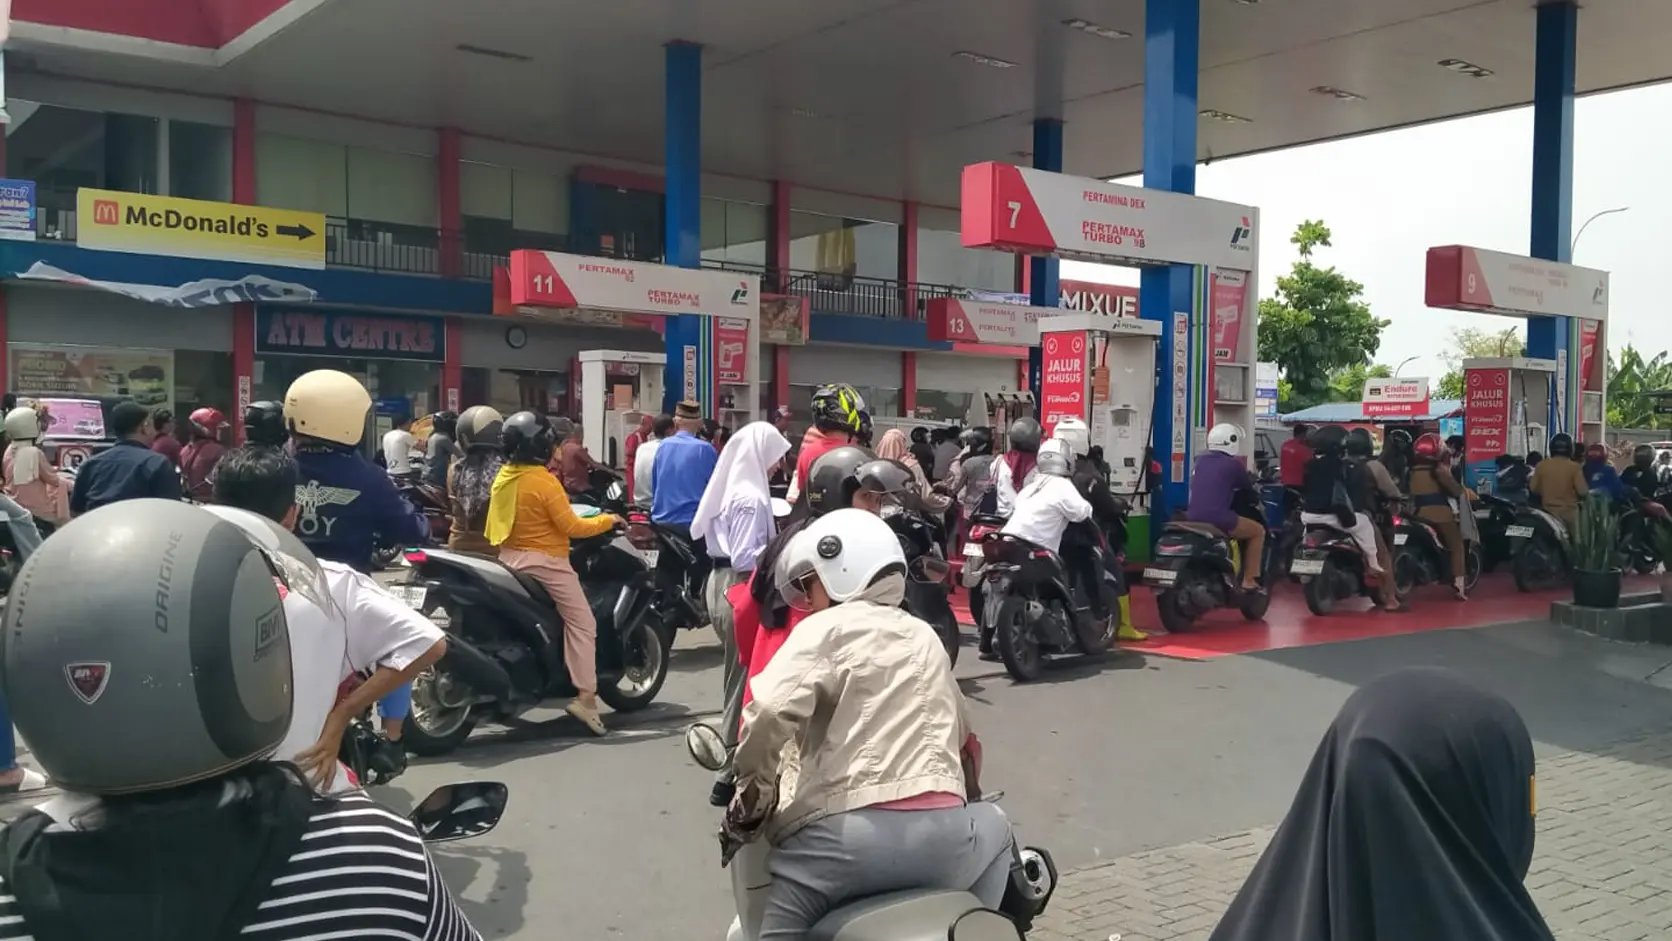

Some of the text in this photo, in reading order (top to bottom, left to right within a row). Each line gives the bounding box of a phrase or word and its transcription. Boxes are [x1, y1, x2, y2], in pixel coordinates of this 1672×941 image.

[125, 205, 269, 238] McDonald's
[1007, 202, 1021, 229] 7
[1082, 221, 1145, 239] PERTAMAX
[1082, 231, 1122, 245] TURBO
[578, 263, 635, 275] PERTAMAX
[533, 274, 553, 294] 11
[1468, 273, 1476, 294] 9
[648, 288, 700, 301] PERTAMAX
[649, 297, 681, 306] TURBO
[1061, 289, 1137, 319] MIXUE
[267, 311, 436, 353] ATM CENTRE
[949, 318, 965, 333] 13
[1048, 358, 1081, 372] JALUR
[1046, 372, 1081, 384] KHUSUS
[1472, 388, 1504, 400] JALUR
[1470, 400, 1504, 409] KHUSUS
